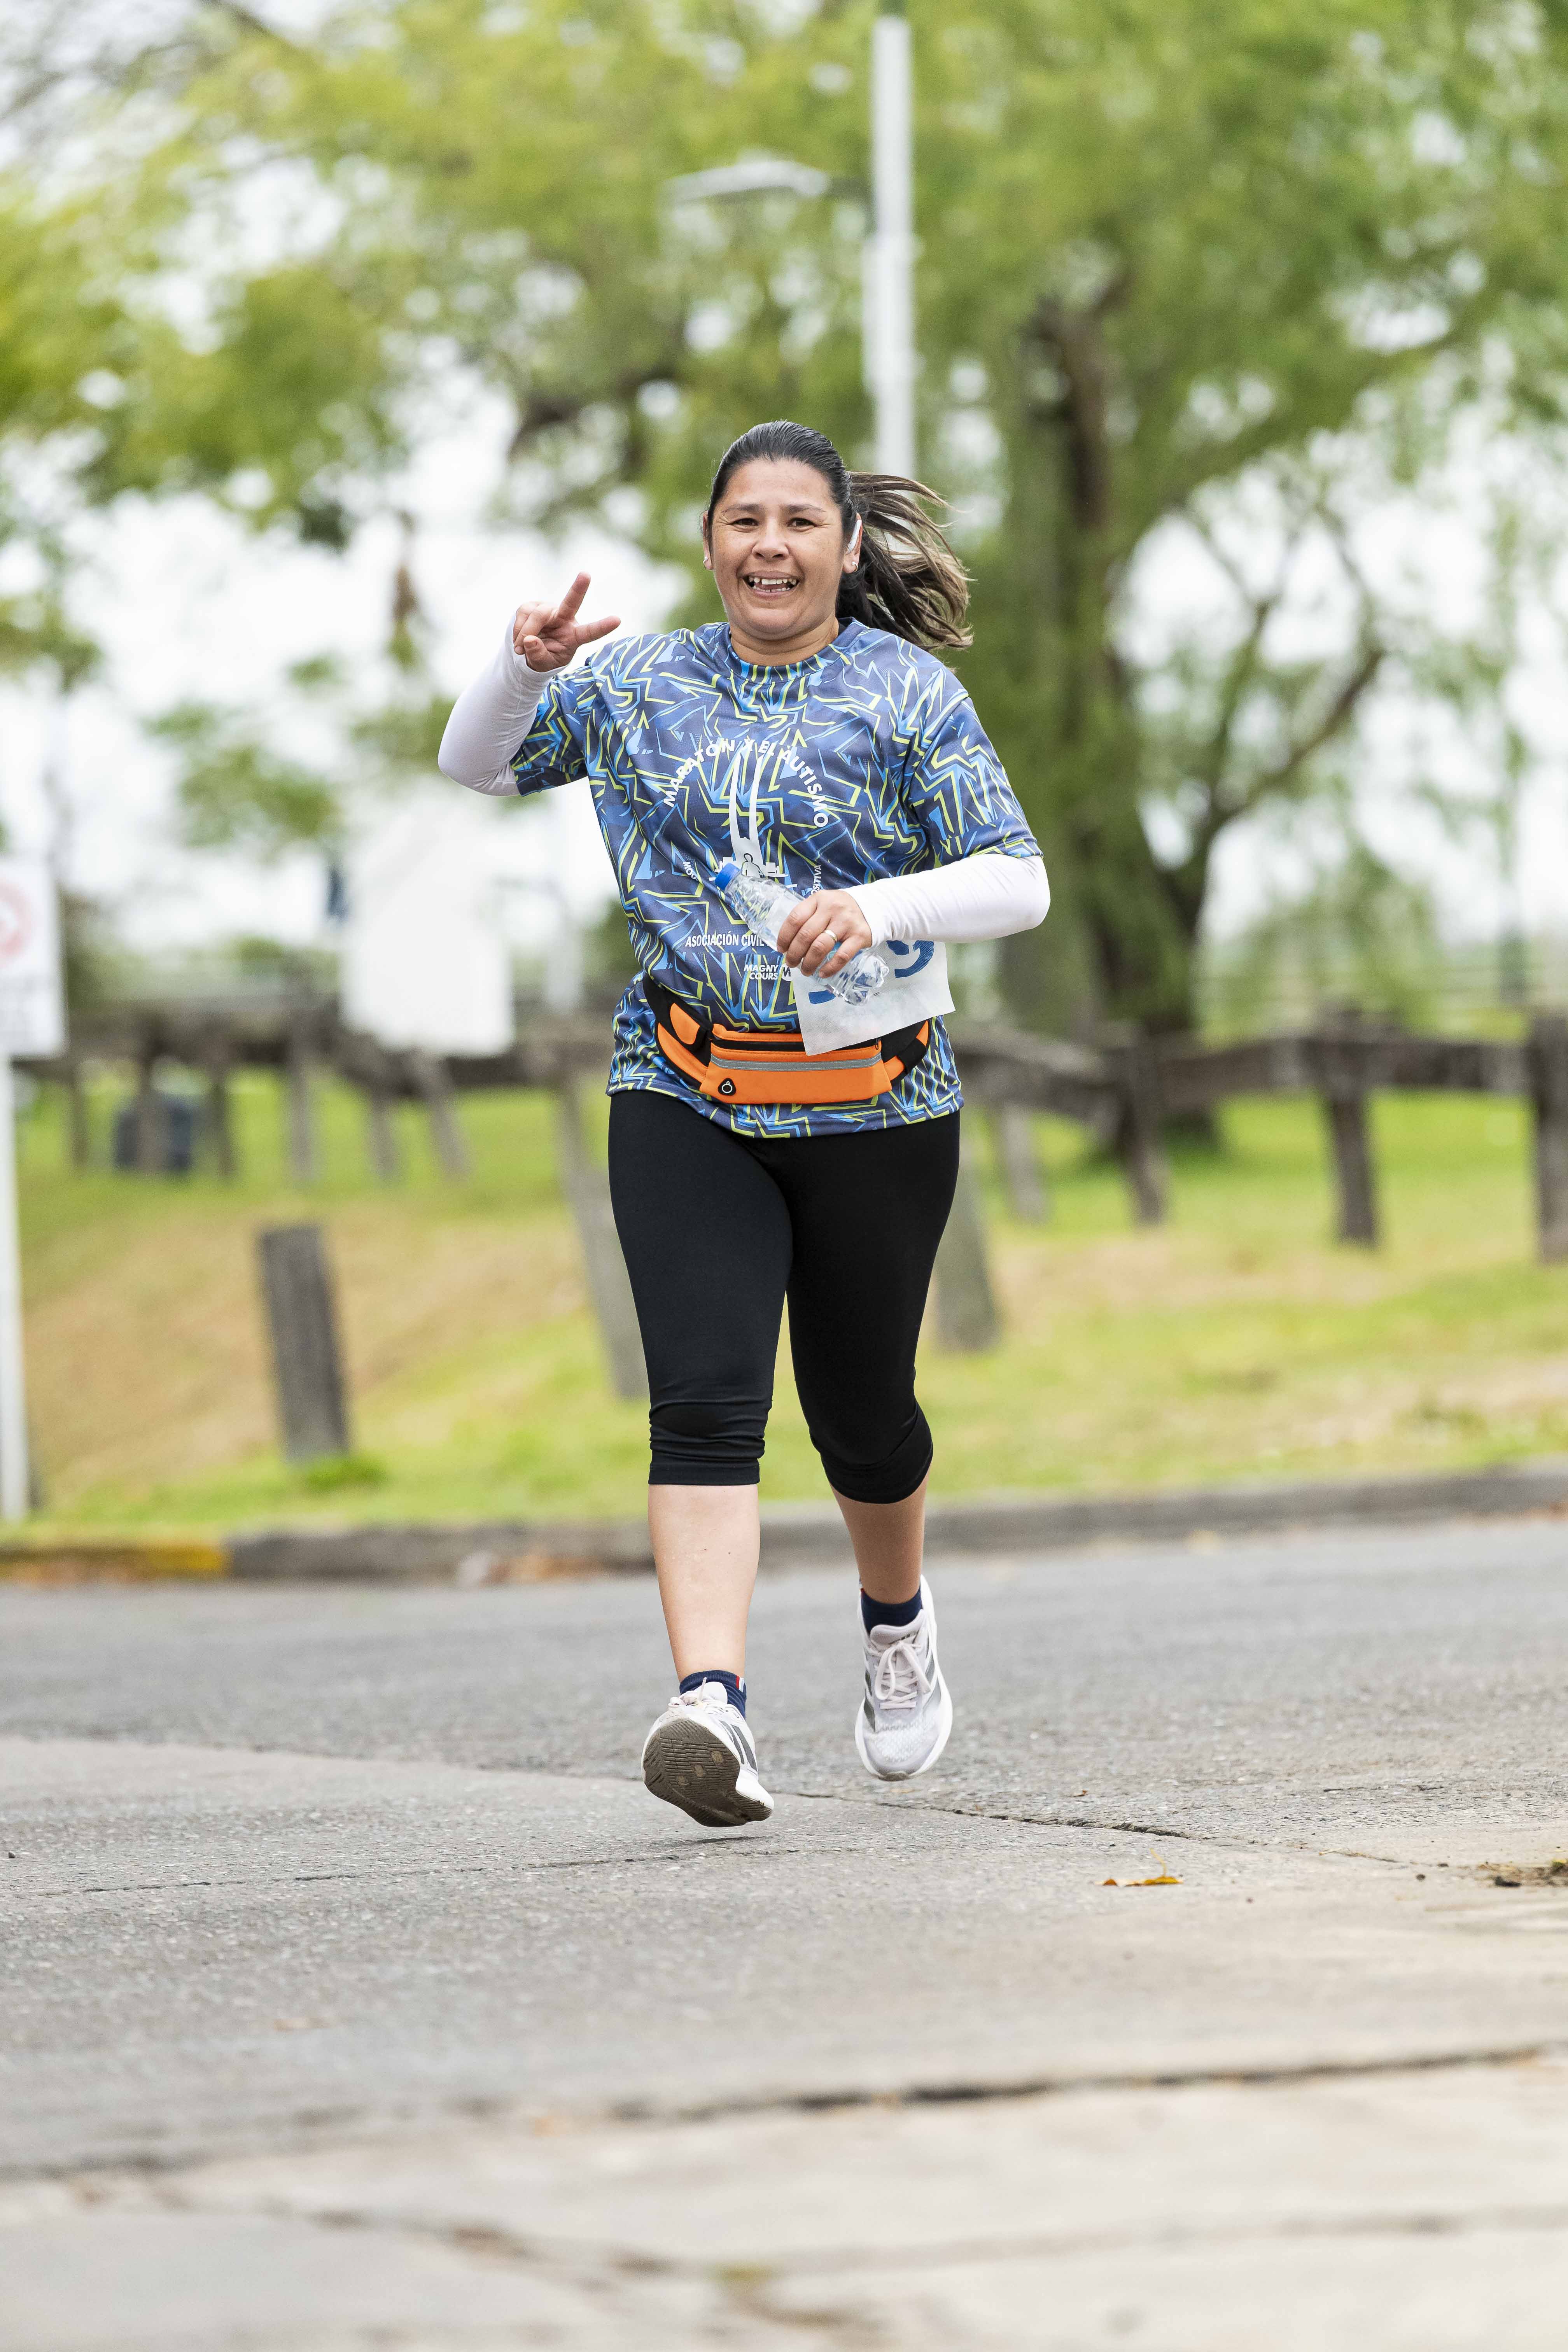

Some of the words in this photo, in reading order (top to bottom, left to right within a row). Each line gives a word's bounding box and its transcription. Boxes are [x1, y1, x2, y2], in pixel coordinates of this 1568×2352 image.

[758, 740, 775, 756] EL
[779, 750, 828, 827] AUTISMO
[810, 865, 822, 895] OSITIVA
[685, 931, 738, 947] ASOCIACIÓN
[741, 934, 765, 947] CIVIL
[744, 964, 779, 972] MAGNY
